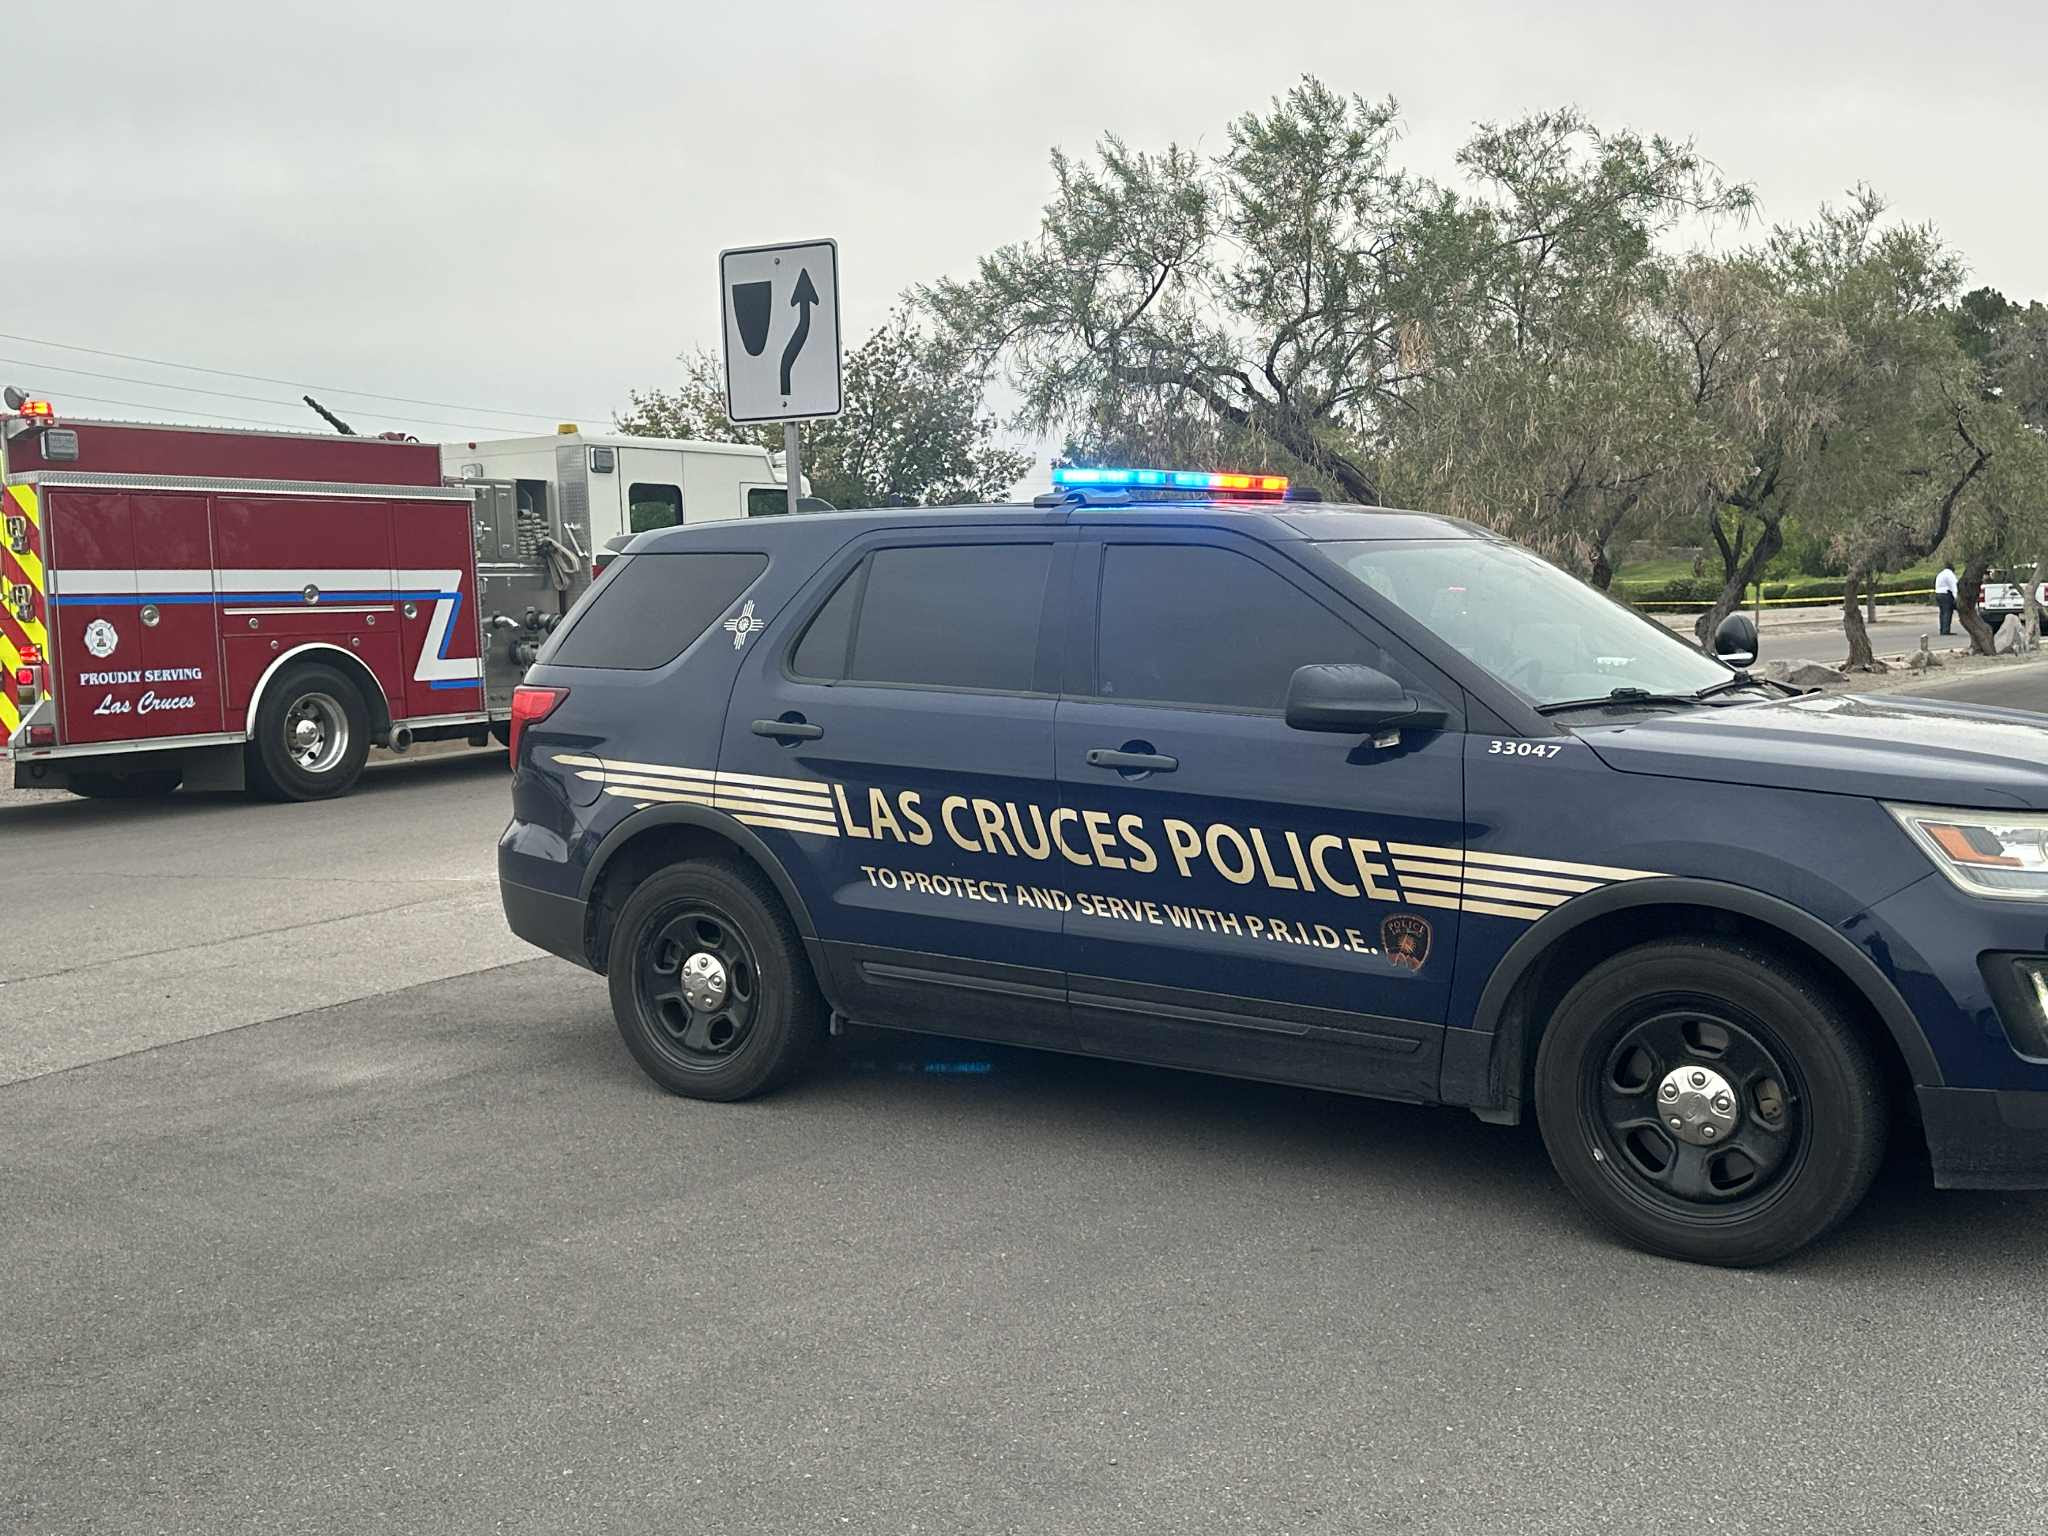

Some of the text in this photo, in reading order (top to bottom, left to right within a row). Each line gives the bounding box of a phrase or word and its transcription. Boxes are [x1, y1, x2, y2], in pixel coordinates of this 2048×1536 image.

[80, 668, 202, 685] PROUDLY SERVING
[93, 690, 196, 715] Las Cruces
[1488, 740, 1561, 758] 33047
[833, 784, 1400, 902] LAS CRUCES POLICE
[861, 865, 1379, 955] TO PROTECT AND SERVE WITH P.R.I.D.E.
